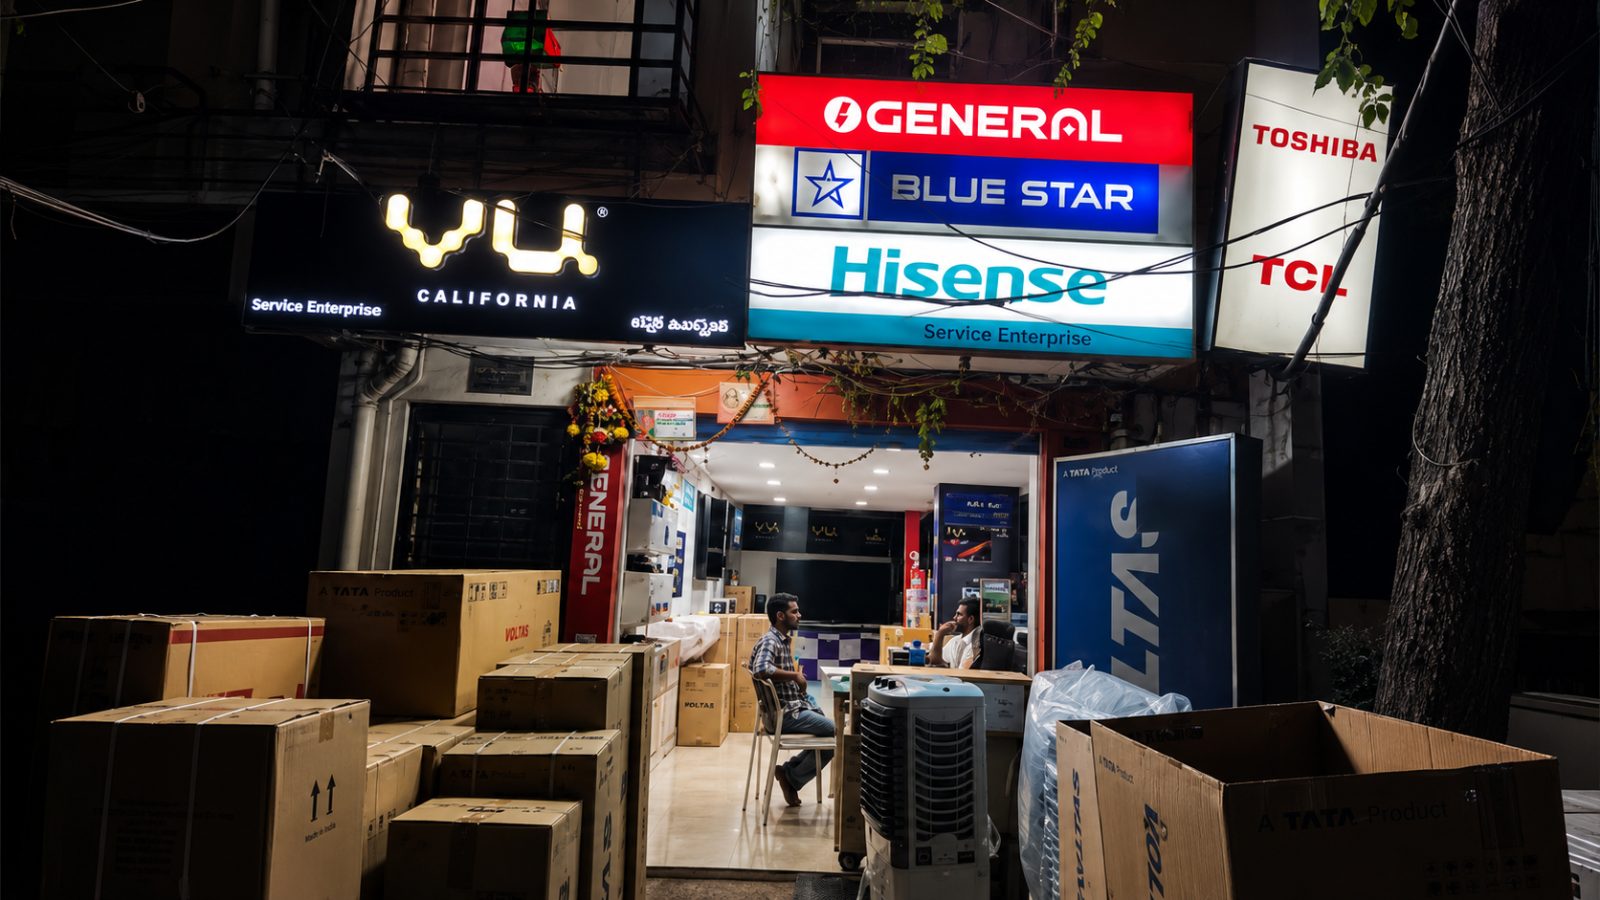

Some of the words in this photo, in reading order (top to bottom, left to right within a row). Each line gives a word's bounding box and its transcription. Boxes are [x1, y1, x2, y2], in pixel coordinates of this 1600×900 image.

[866, 100, 1123, 143] GENERAL
[1252, 124, 1377, 162] TOSHIBA
[892, 173, 1006, 205] BLUE
[1021, 180, 1134, 212] STAR
[386, 194, 598, 276] VU
[830, 246, 1108, 305] Hisense
[1252, 254, 1347, 297] TCL
[251, 298, 304, 315] Service
[307, 301, 382, 318] Enterprise
[417, 289, 577, 310] CALIFORNIA
[923, 323, 992, 343] Service
[998, 326, 1092, 347] Enterprise
[1063, 470, 1069, 478] A
[1070, 468, 1090, 478] TATA
[1091, 465, 1118, 477] Product
[581, 455, 610, 596] ENERAL
[318, 586, 328, 597] A
[332, 586, 369, 597] TATA
[374, 587, 415, 599] Product
[505, 624, 529, 642] VOLTAS
[1258, 813, 1275, 832] A
[1283, 807, 1357, 831] TATA
[1367, 801, 1449, 825] Product
[1144, 803, 1165, 900] VOL
